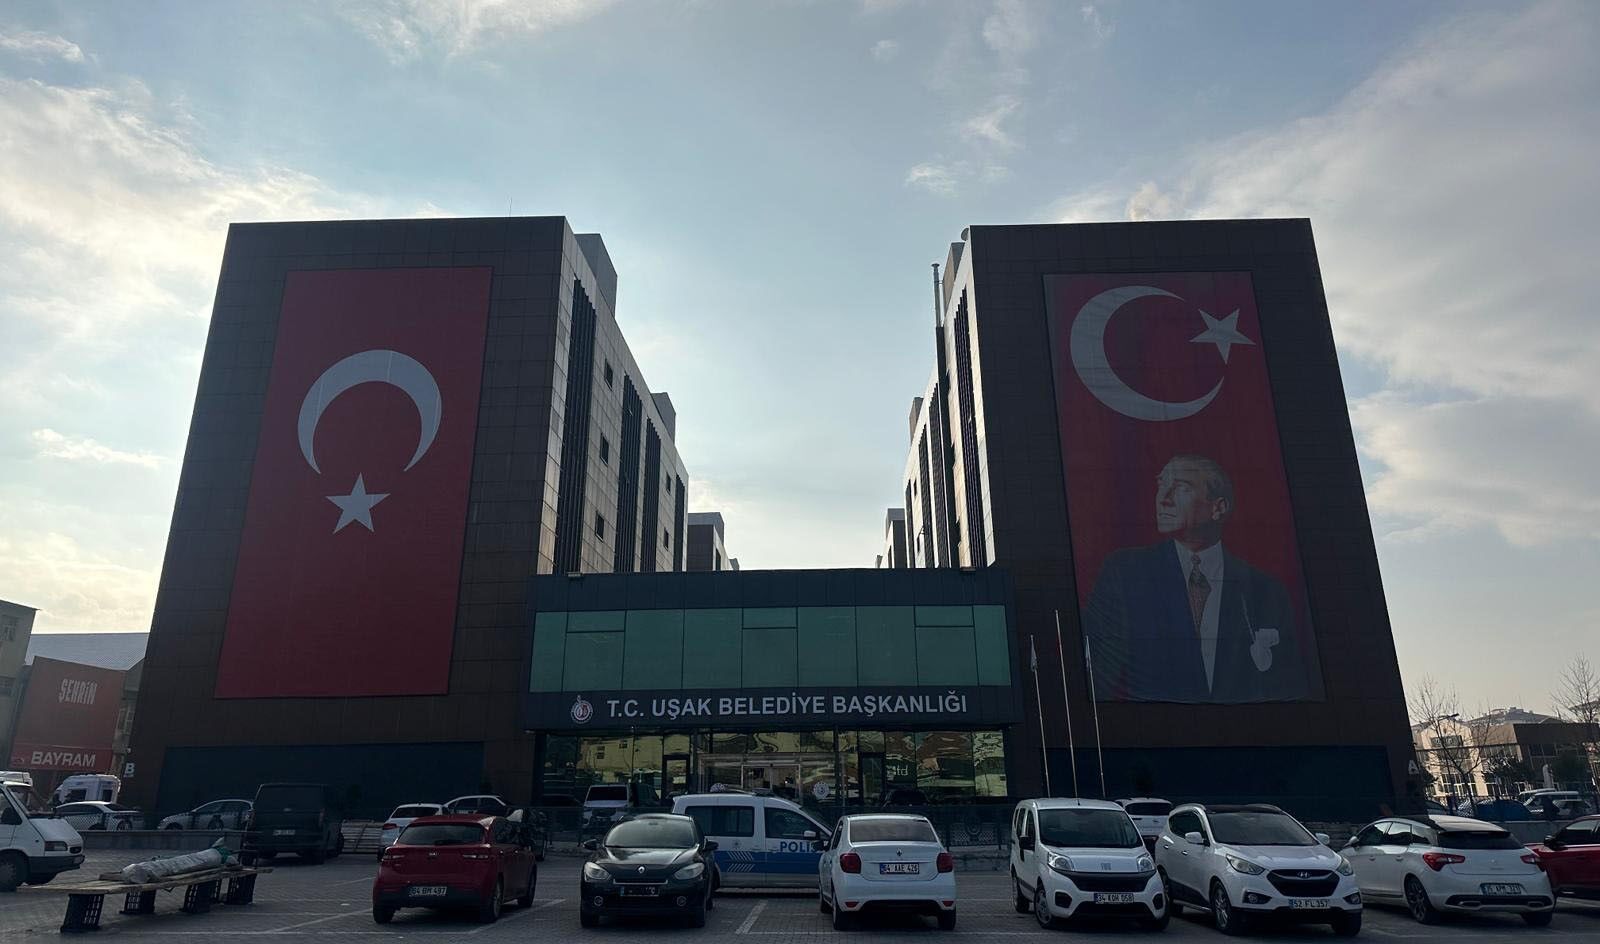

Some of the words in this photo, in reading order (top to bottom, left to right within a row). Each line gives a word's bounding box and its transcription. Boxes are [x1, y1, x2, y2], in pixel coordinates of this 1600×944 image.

[607, 699, 645, 718] T.C.
[652, 697, 712, 720] UŞAK
[719, 691, 825, 716] BELEDİYE
[832, 689, 967, 718] BAŞKANLIĞI
[31, 751, 96, 768] BAYRAM
[1408, 759, 1419, 775] A
[125, 763, 135, 775] B
